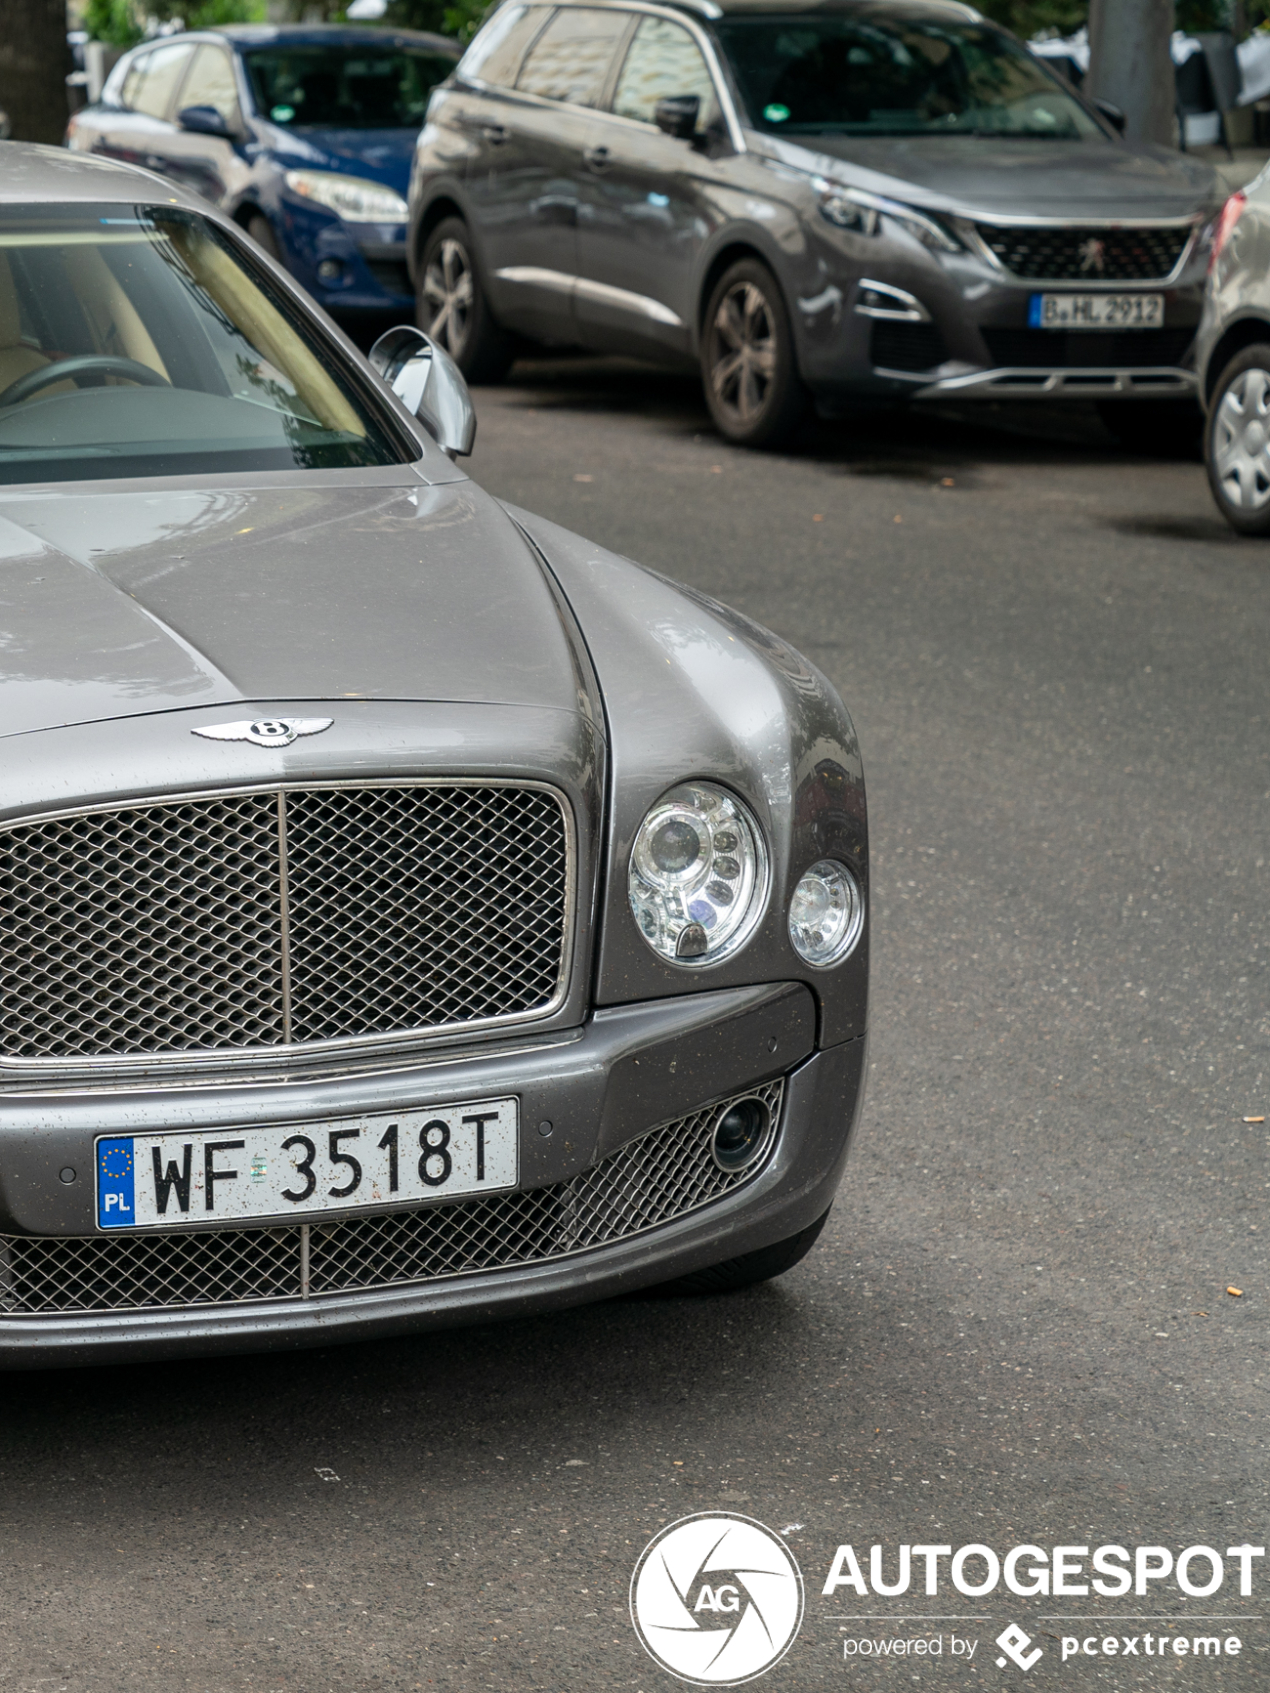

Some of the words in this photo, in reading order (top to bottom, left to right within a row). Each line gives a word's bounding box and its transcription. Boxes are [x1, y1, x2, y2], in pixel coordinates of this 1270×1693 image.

[1105, 295, 1160, 321] 2912
[151, 1139, 245, 1215] WF
[279, 1111, 499, 1202] 3518T
[104, 1193, 130, 1212] PL
